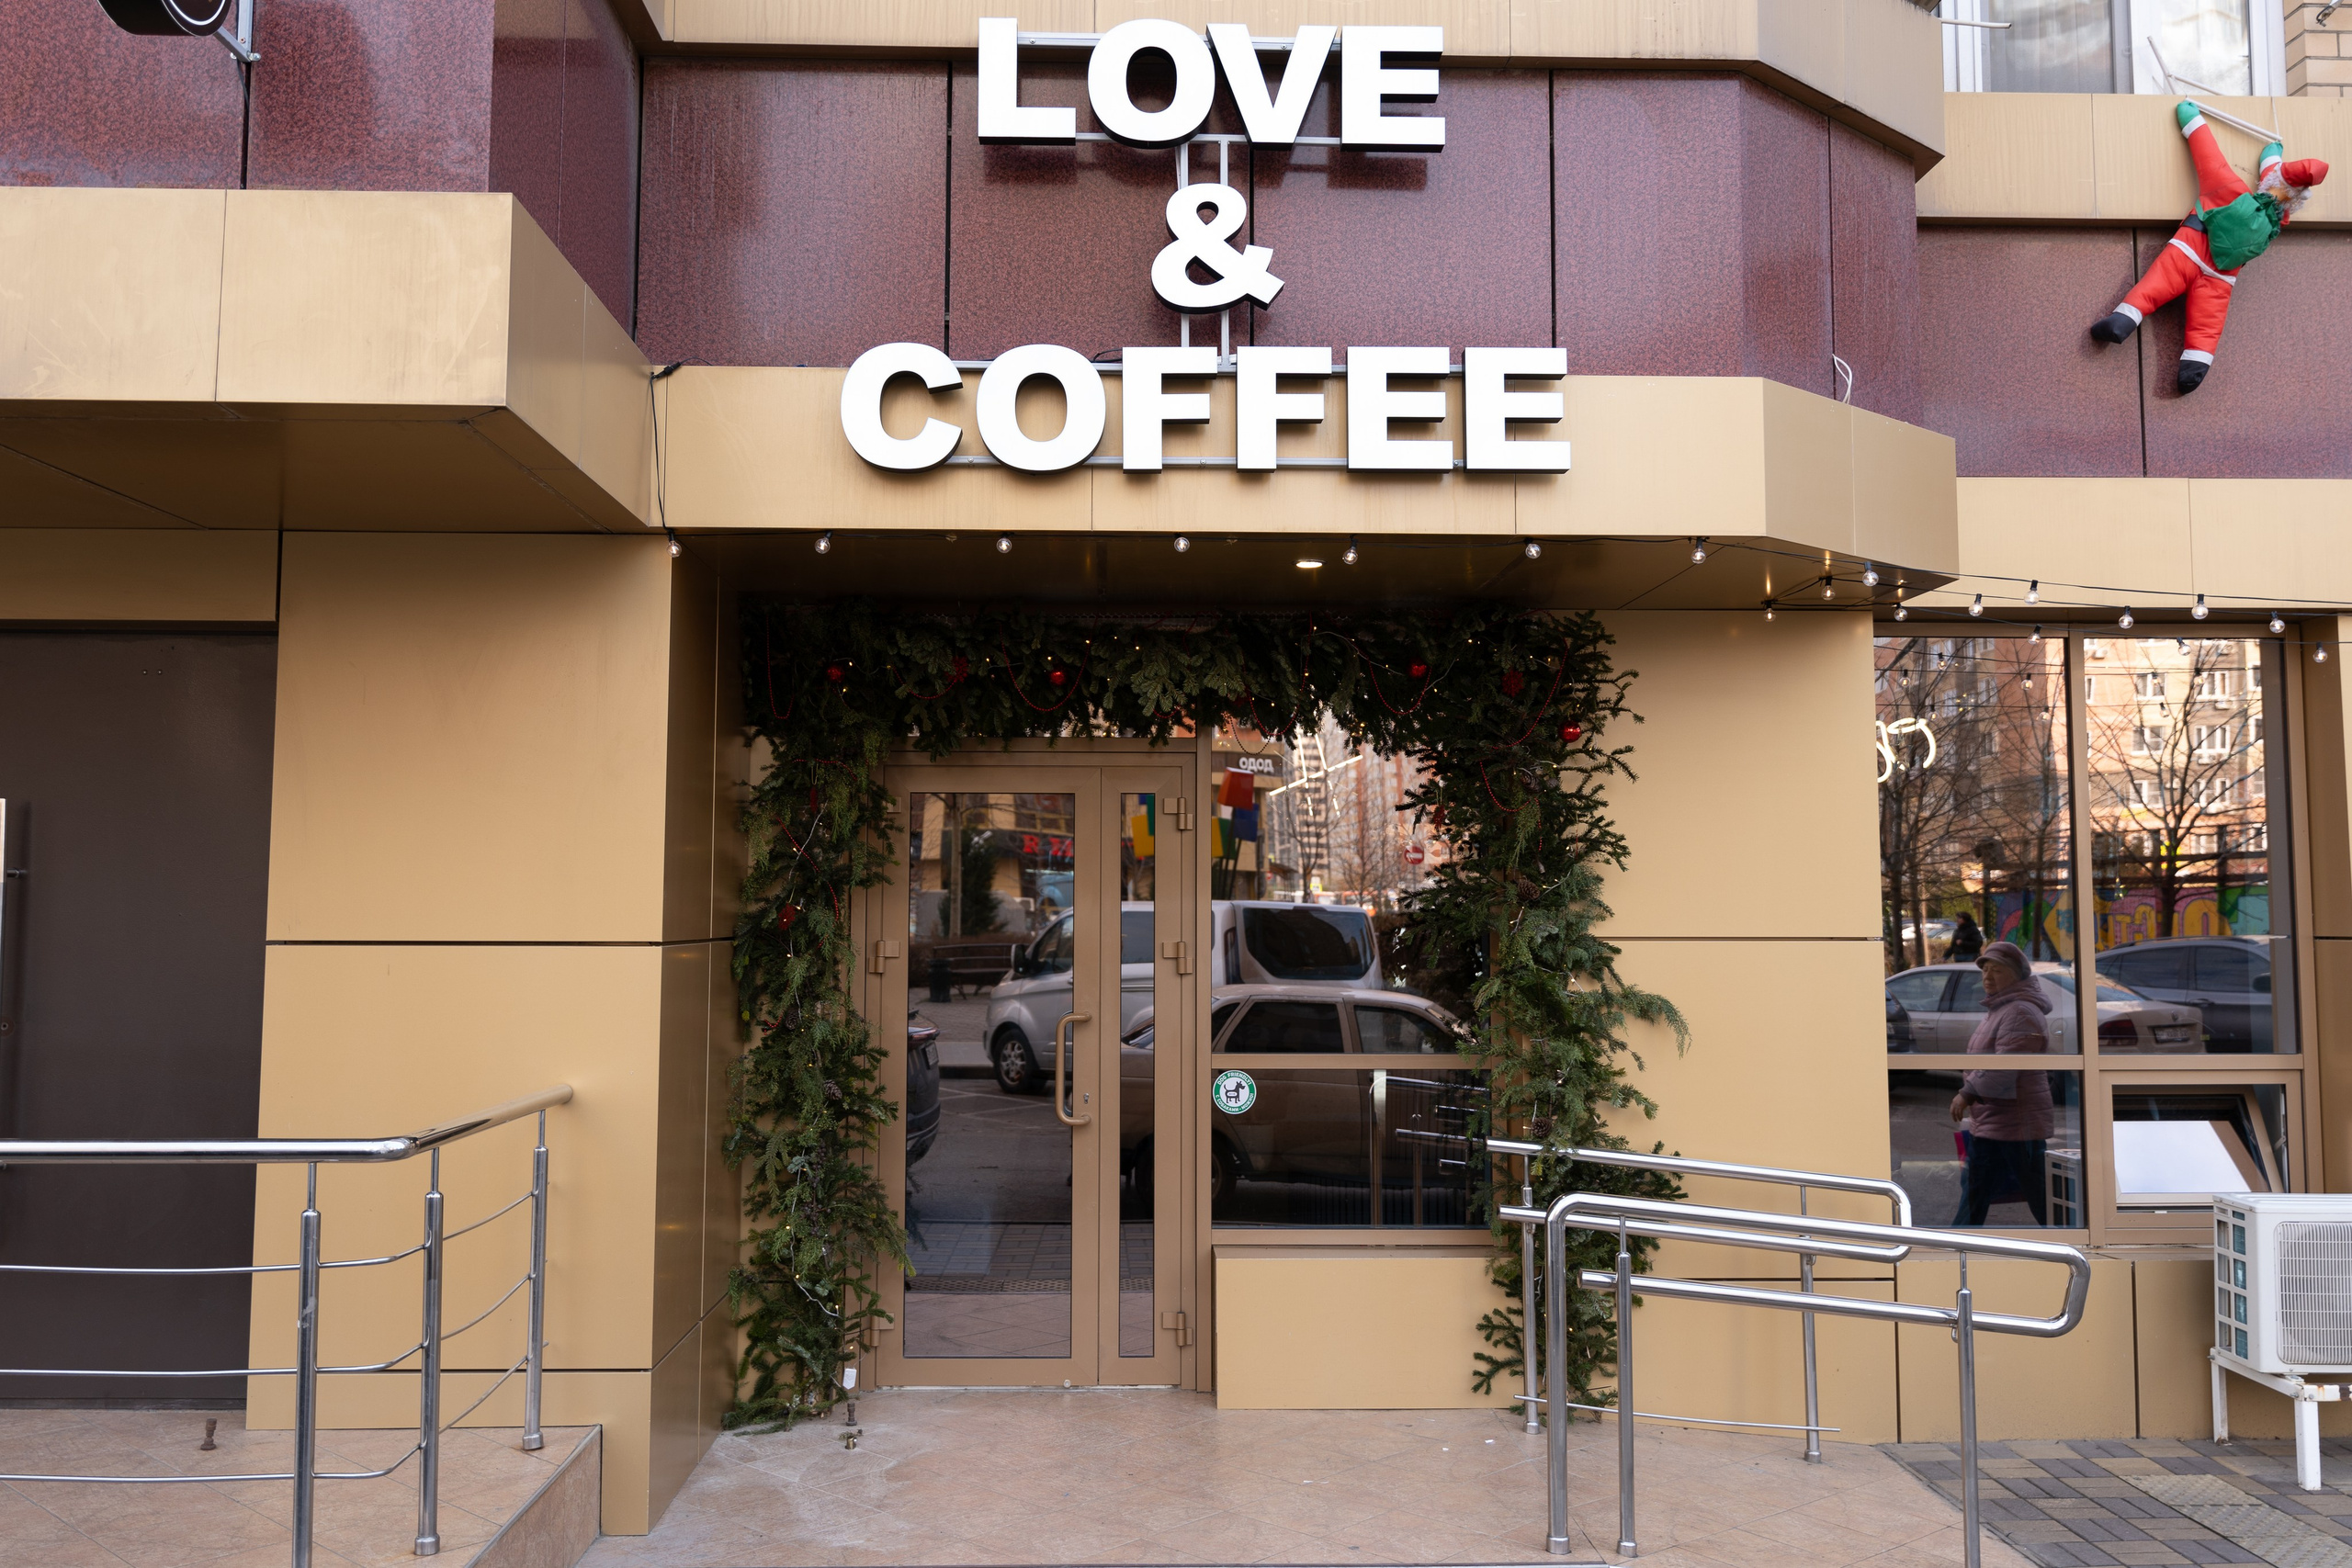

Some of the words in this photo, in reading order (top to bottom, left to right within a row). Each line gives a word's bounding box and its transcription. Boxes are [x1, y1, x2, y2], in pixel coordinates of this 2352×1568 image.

[978, 17, 1445, 152] LOVE
[1150, 183, 1285, 314] &
[841, 342, 1571, 475] COFFEE
[1217, 1076, 1227, 1085] DOG
[1217, 1099, 1238, 1111] СОБАКАМИ
